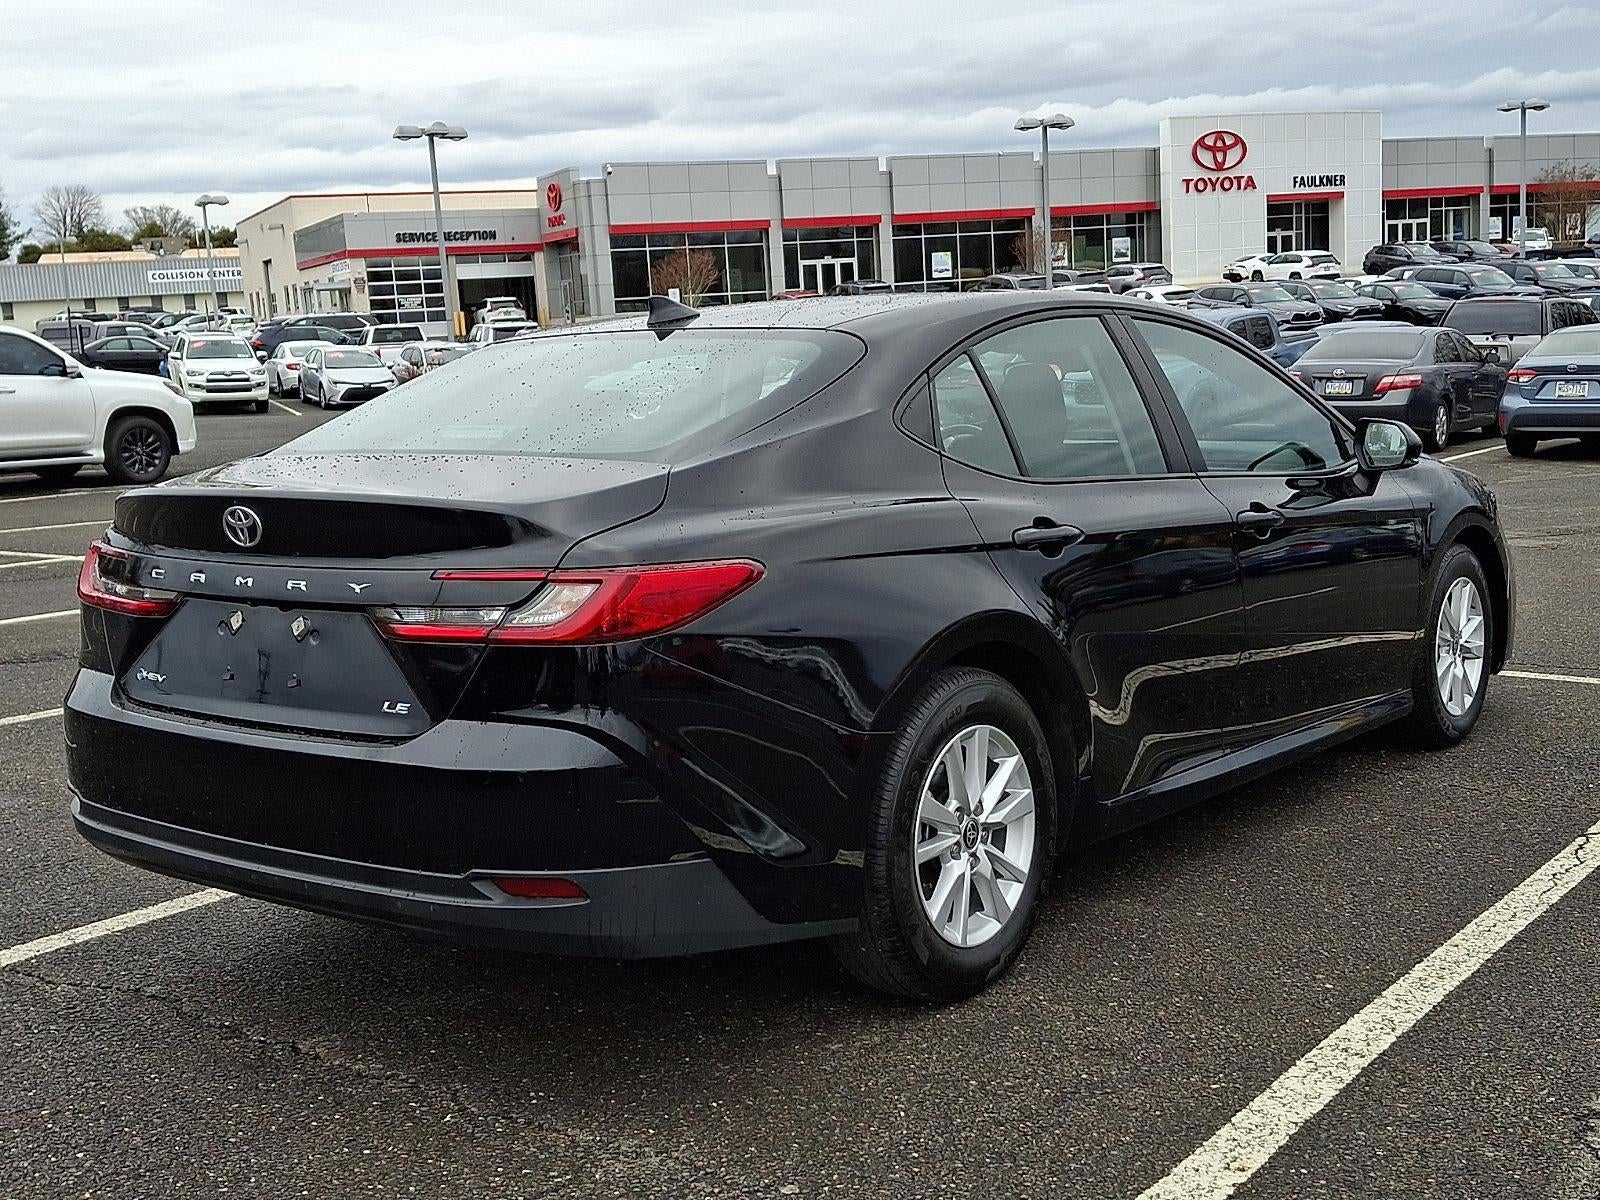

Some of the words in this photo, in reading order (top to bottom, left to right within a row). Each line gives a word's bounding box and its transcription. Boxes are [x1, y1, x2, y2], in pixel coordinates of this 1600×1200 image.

[1182, 175, 1257, 193] TOYOTA
[1293, 174, 1346, 188] FAULKNER
[395, 231, 439, 243] SERVICE
[151, 271, 204, 280] COLLISION
[151, 568, 372, 594] CAMRY
[381, 701, 411, 715] LE
